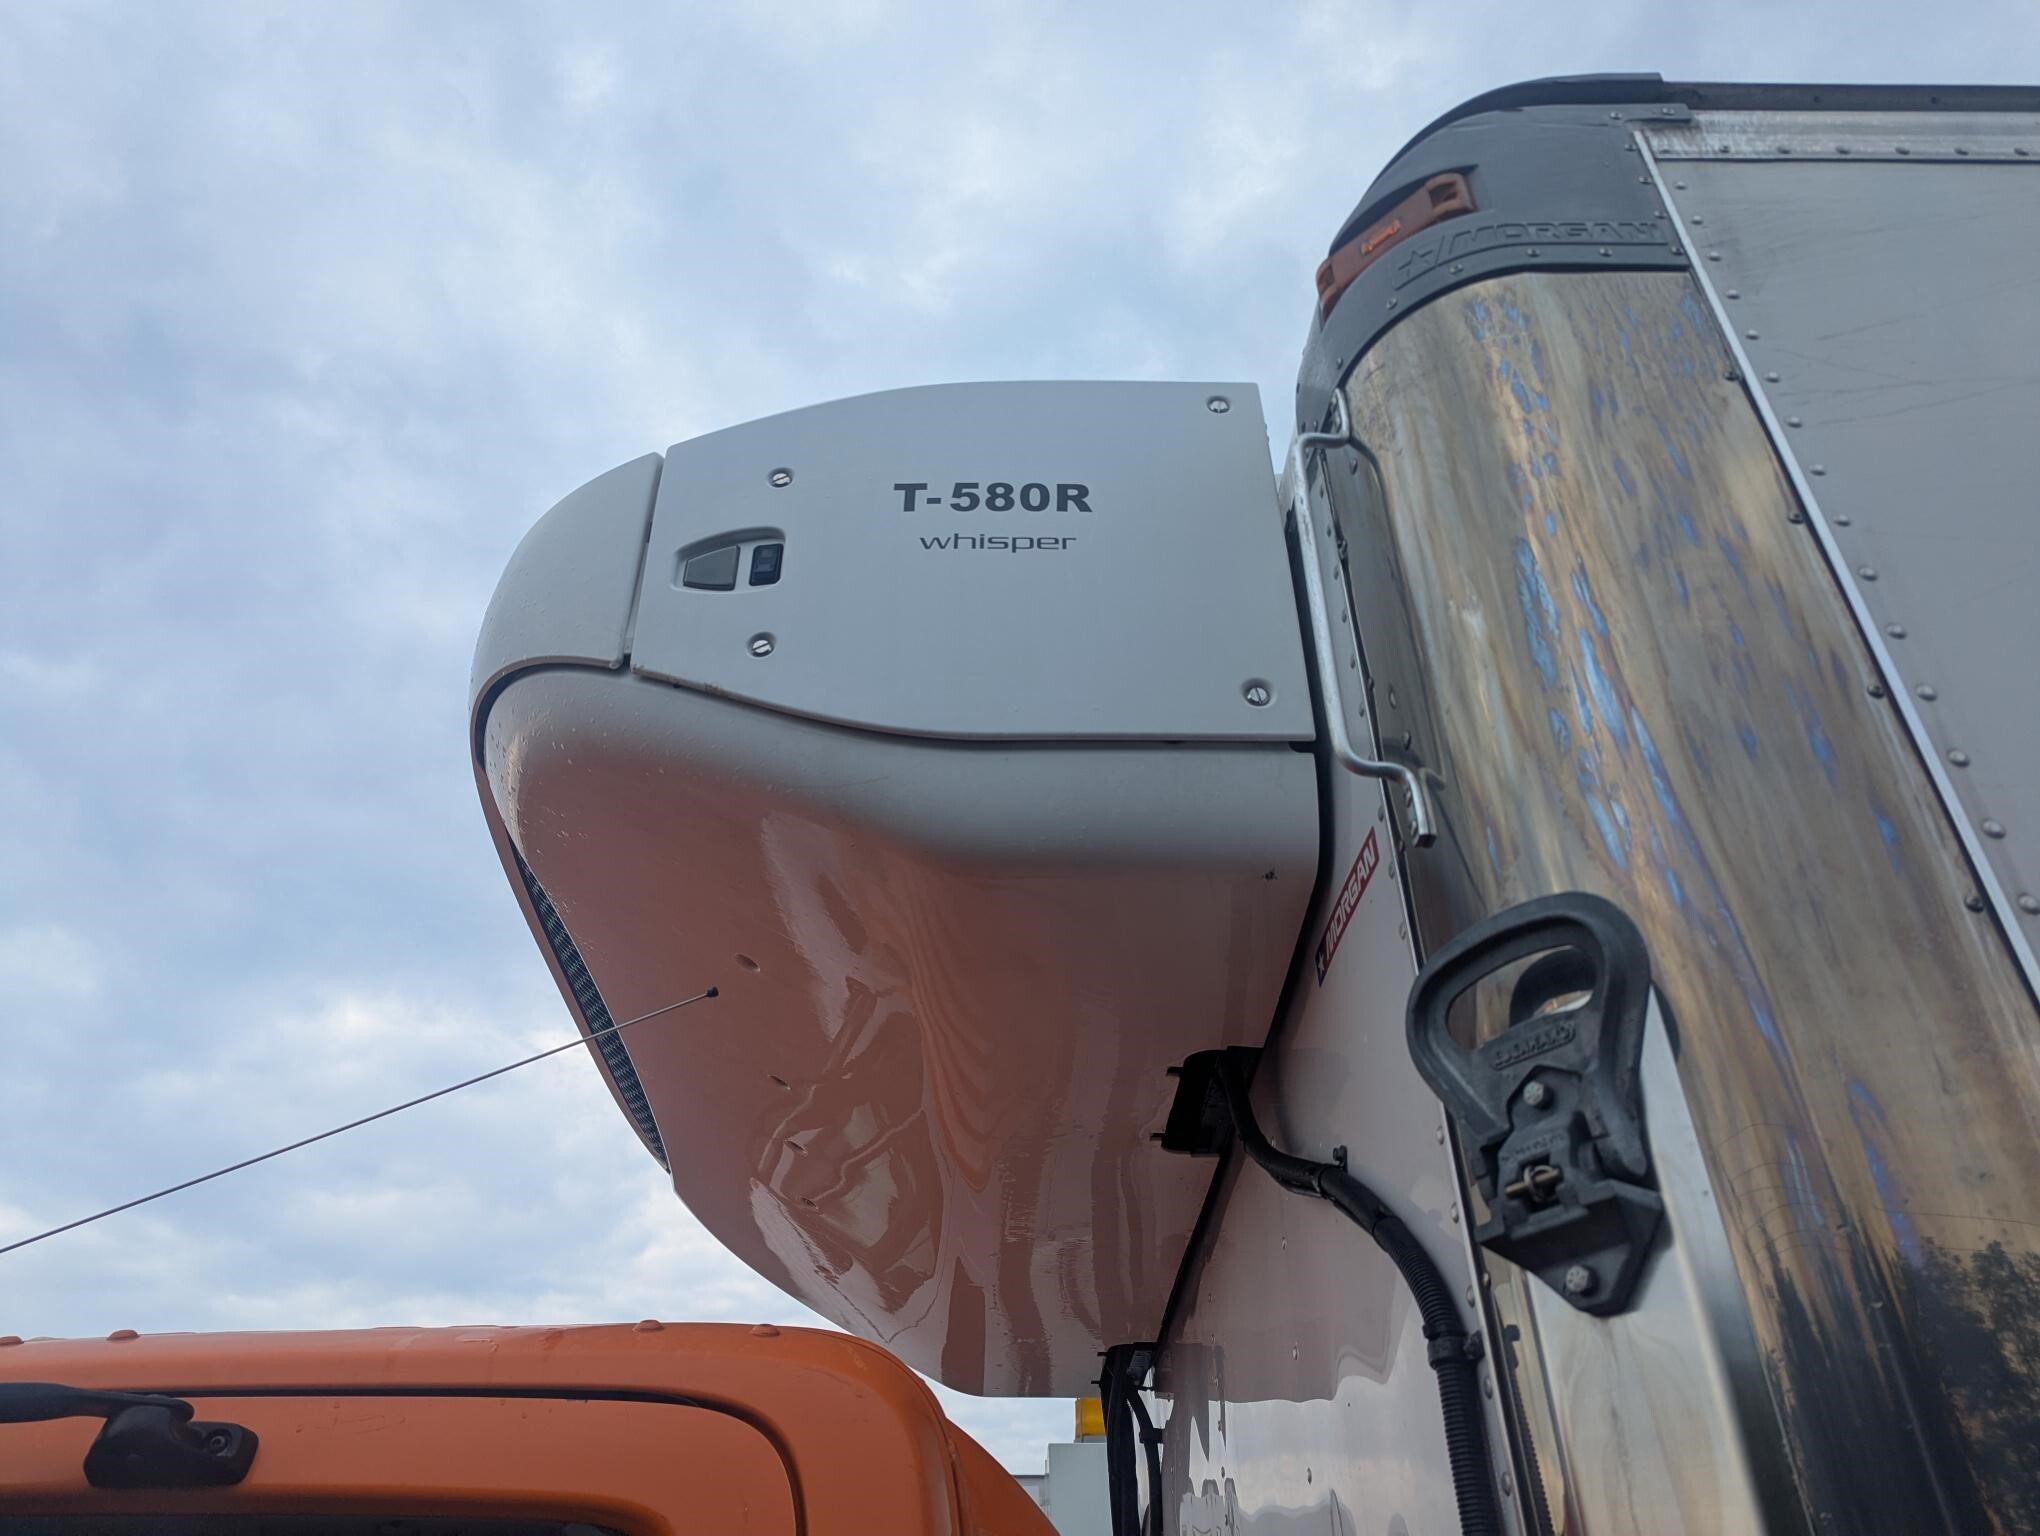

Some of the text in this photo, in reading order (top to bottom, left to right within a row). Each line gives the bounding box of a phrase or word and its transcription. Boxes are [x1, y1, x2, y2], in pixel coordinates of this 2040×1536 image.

[1447, 221, 1656, 256] MORGAN
[893, 482, 1093, 513] T-580R
[919, 532, 1077, 554] whisper
[1324, 838, 1378, 957] MORGAN
